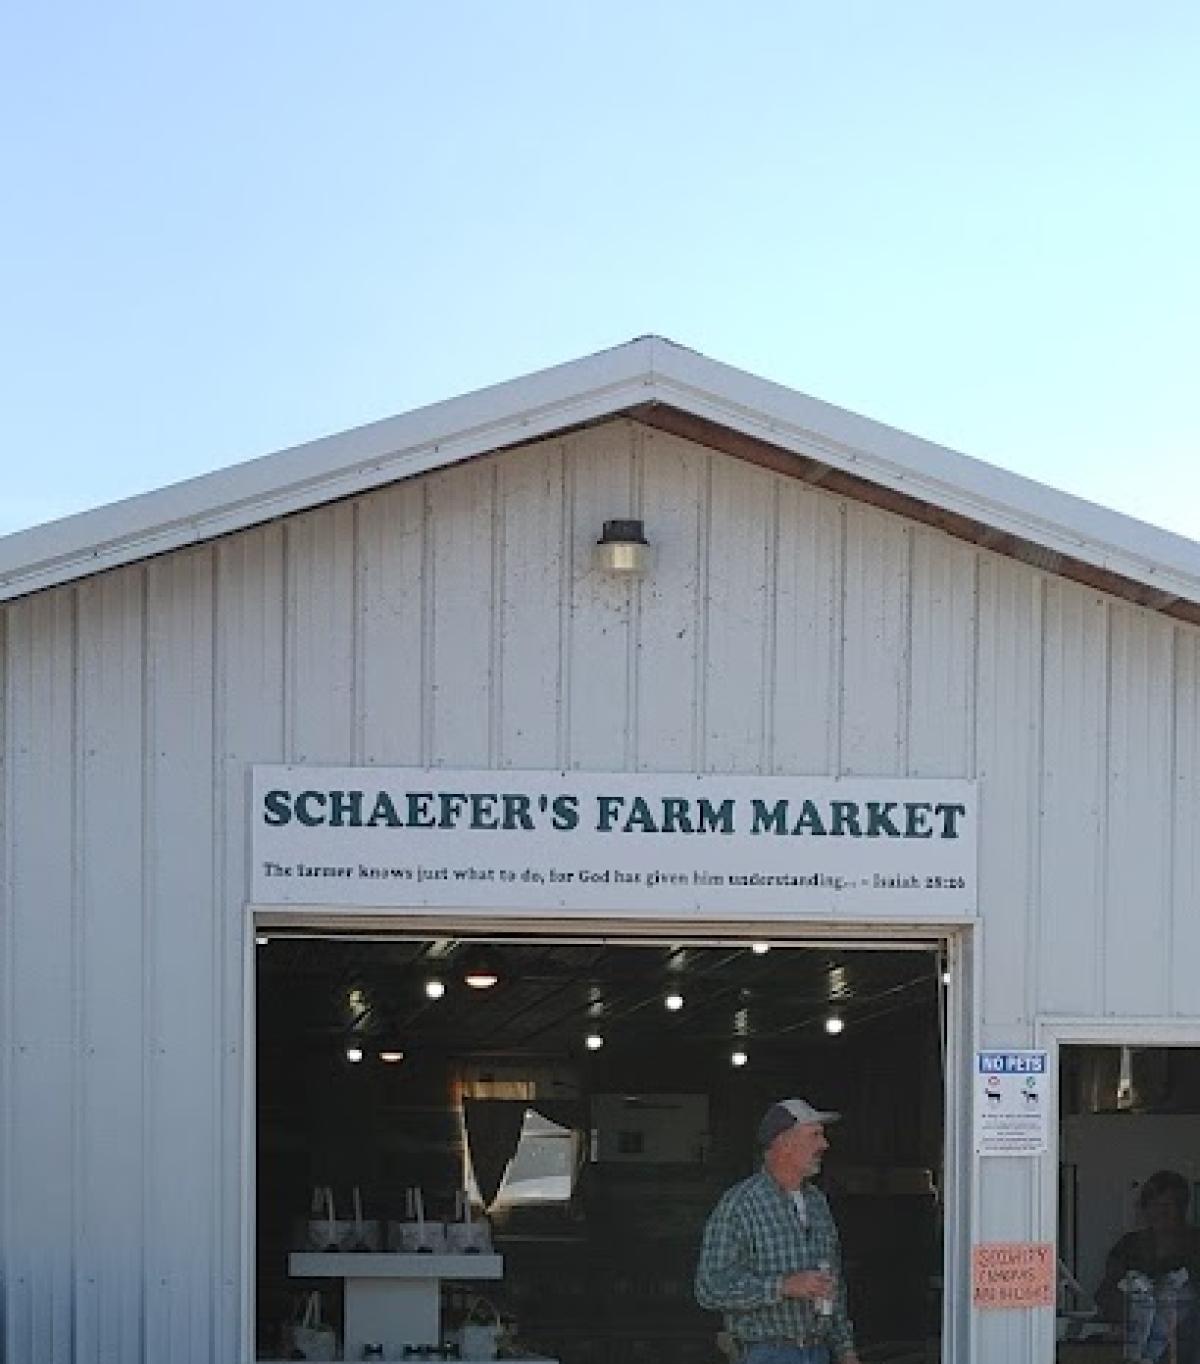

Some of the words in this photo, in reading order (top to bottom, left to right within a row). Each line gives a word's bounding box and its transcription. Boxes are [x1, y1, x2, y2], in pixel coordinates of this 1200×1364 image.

[264, 790, 579, 830] SCHAEFER'S
[596, 796, 736, 833] FARM
[750, 799, 966, 838] MARKET
[264, 862, 292, 877] The
[297, 863, 353, 878] farmer
[359, 864, 412, 879] knows
[417, 865, 448, 883] just
[453, 867, 495, 881] what
[500, 868, 516, 882] to
[520, 868, 545, 884] do,
[550, 868, 575, 883] for
[579, 868, 610, 883] God
[614, 869, 641, 884] has
[646, 870, 688, 887] given
[693, 870, 724, 886] him
[873, 873, 921, 889] Isaiah
[982, 1055, 1003, 1071] NO
[1006, 1055, 1042, 1071] PETS
